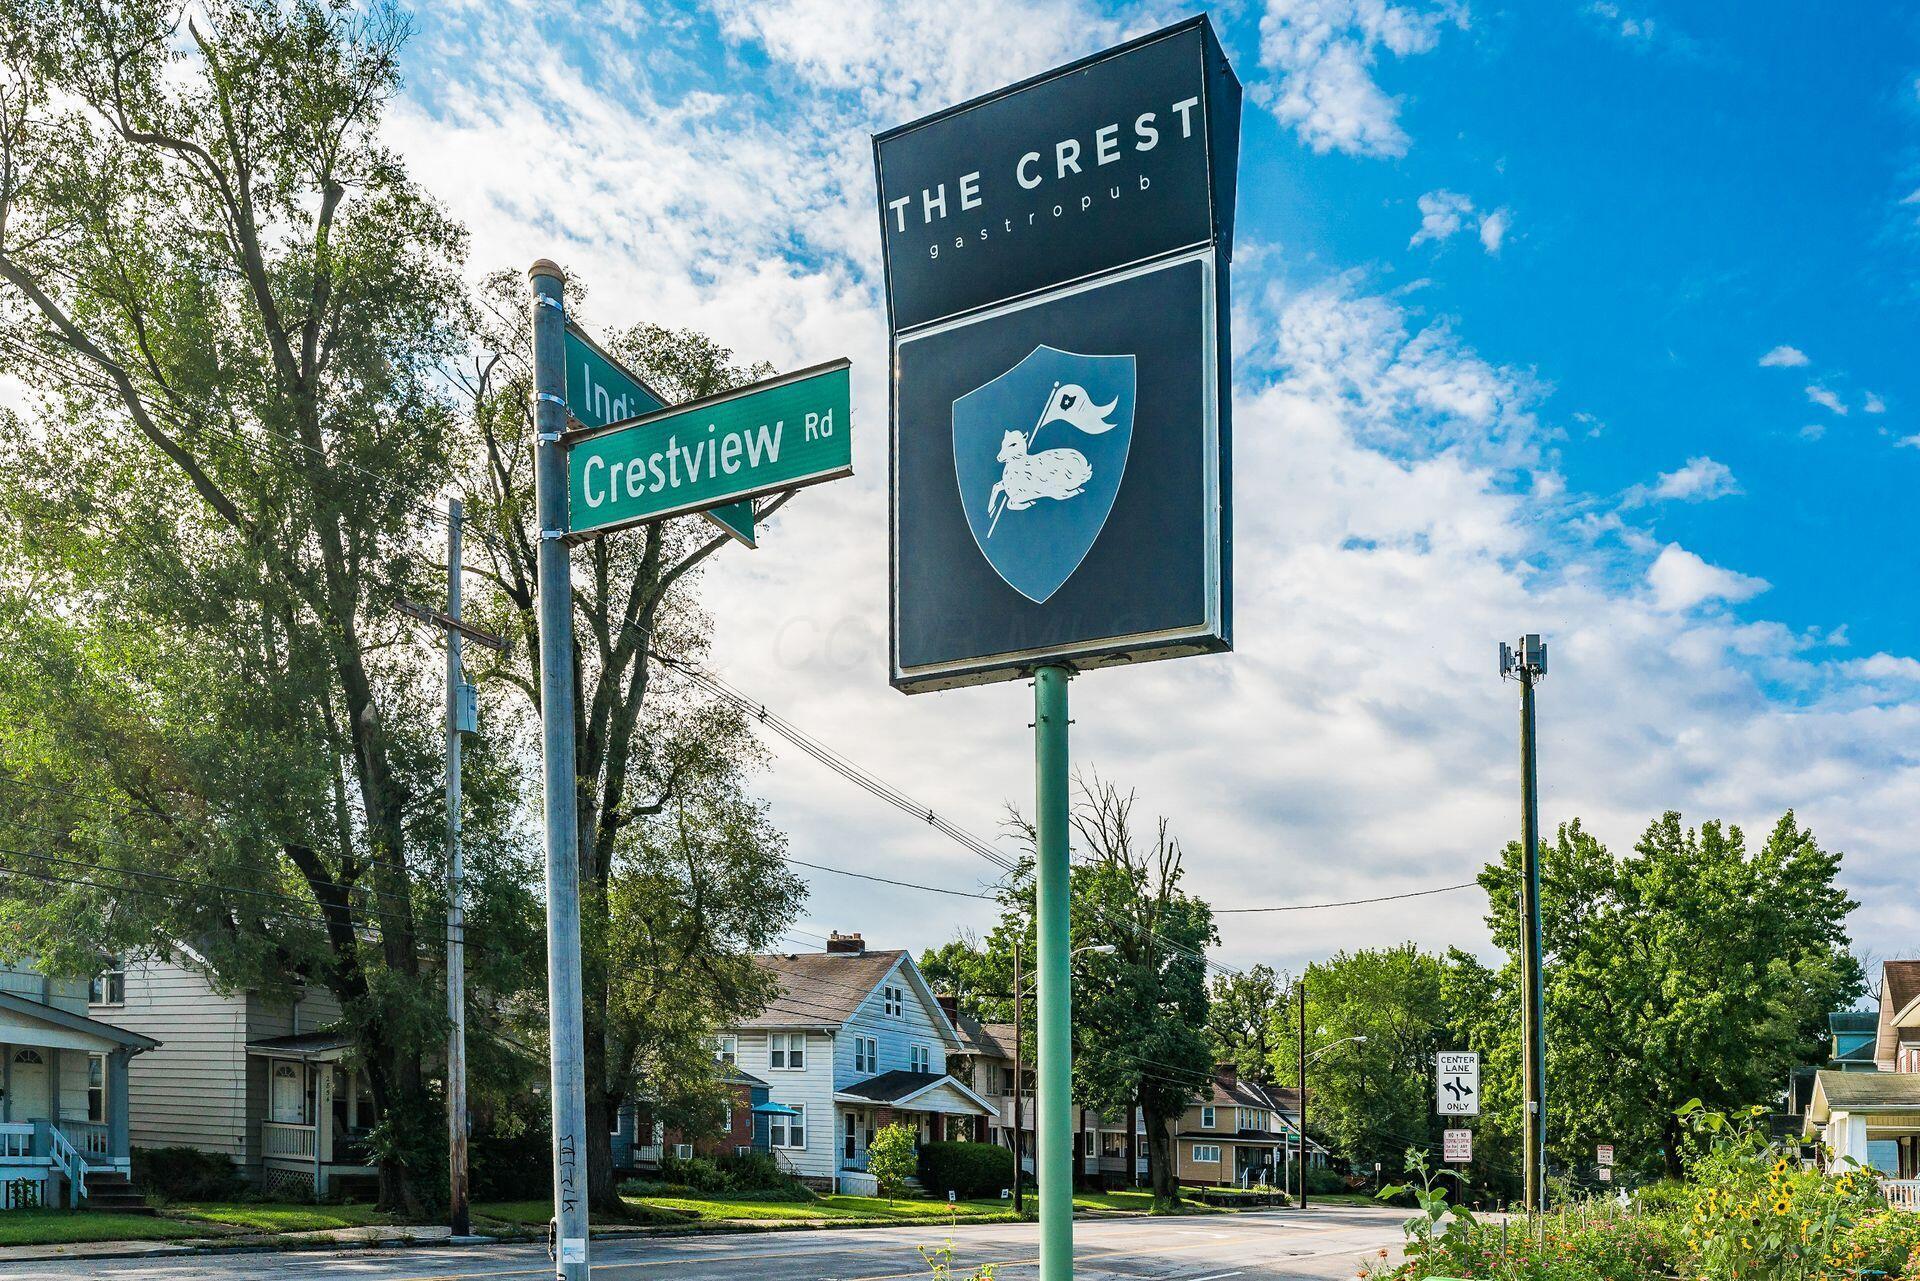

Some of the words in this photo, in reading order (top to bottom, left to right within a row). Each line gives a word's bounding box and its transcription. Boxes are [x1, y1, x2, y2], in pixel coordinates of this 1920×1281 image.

[889, 171, 982, 233] THE
[1016, 96, 1198, 190] CREST
[929, 174, 1150, 259] gastropub
[583, 420, 784, 508] Crestview
[805, 408, 833, 442] Rd
[1441, 1056, 1475, 1064] CENTER
[1446, 1103, 1469, 1111] ONLY
